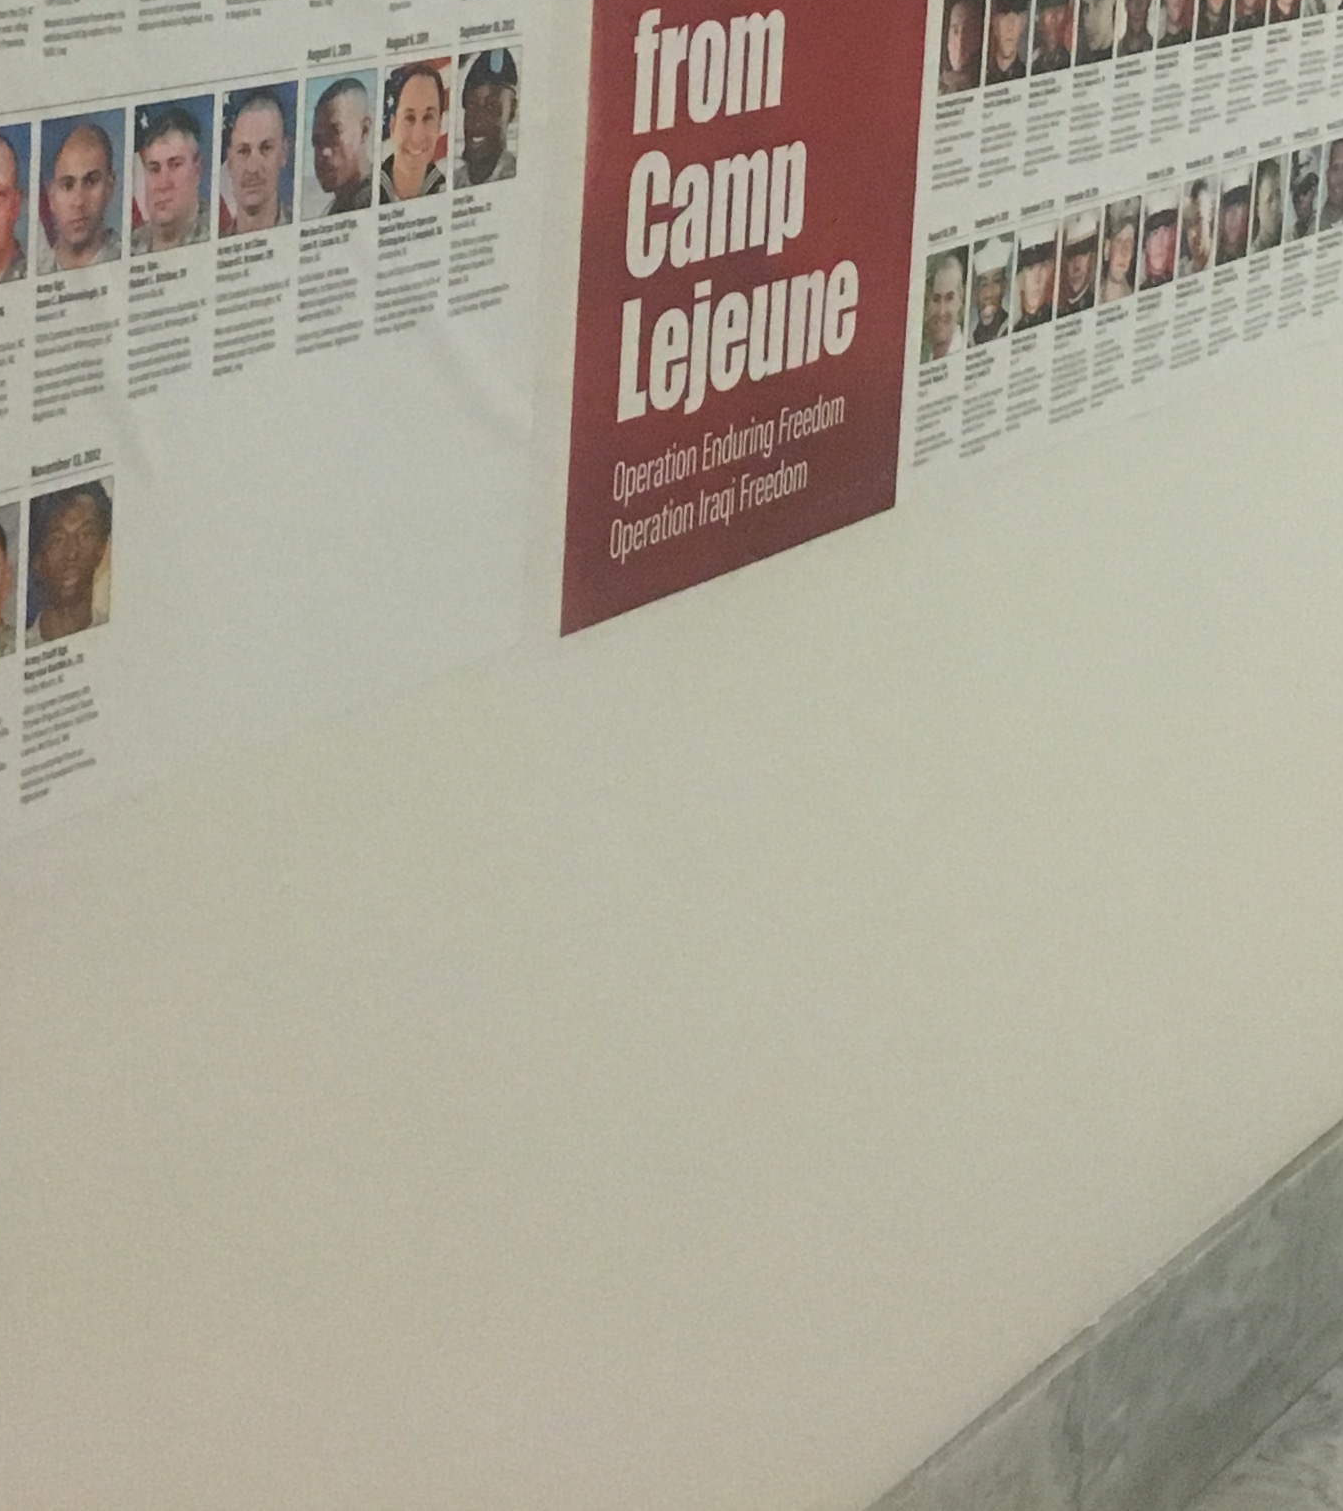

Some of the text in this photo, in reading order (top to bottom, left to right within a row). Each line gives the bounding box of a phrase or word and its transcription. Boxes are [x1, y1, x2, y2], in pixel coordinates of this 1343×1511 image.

[633, 8, 786, 135] from
[625, 140, 807, 279] Camp
[616, 259, 858, 423] Lejeune
[31, 458, 71, 477] November
[613, 394, 845, 507] Operation Enduring Freedom
[609, 460, 807, 565] Operation Iraqi Freedom
